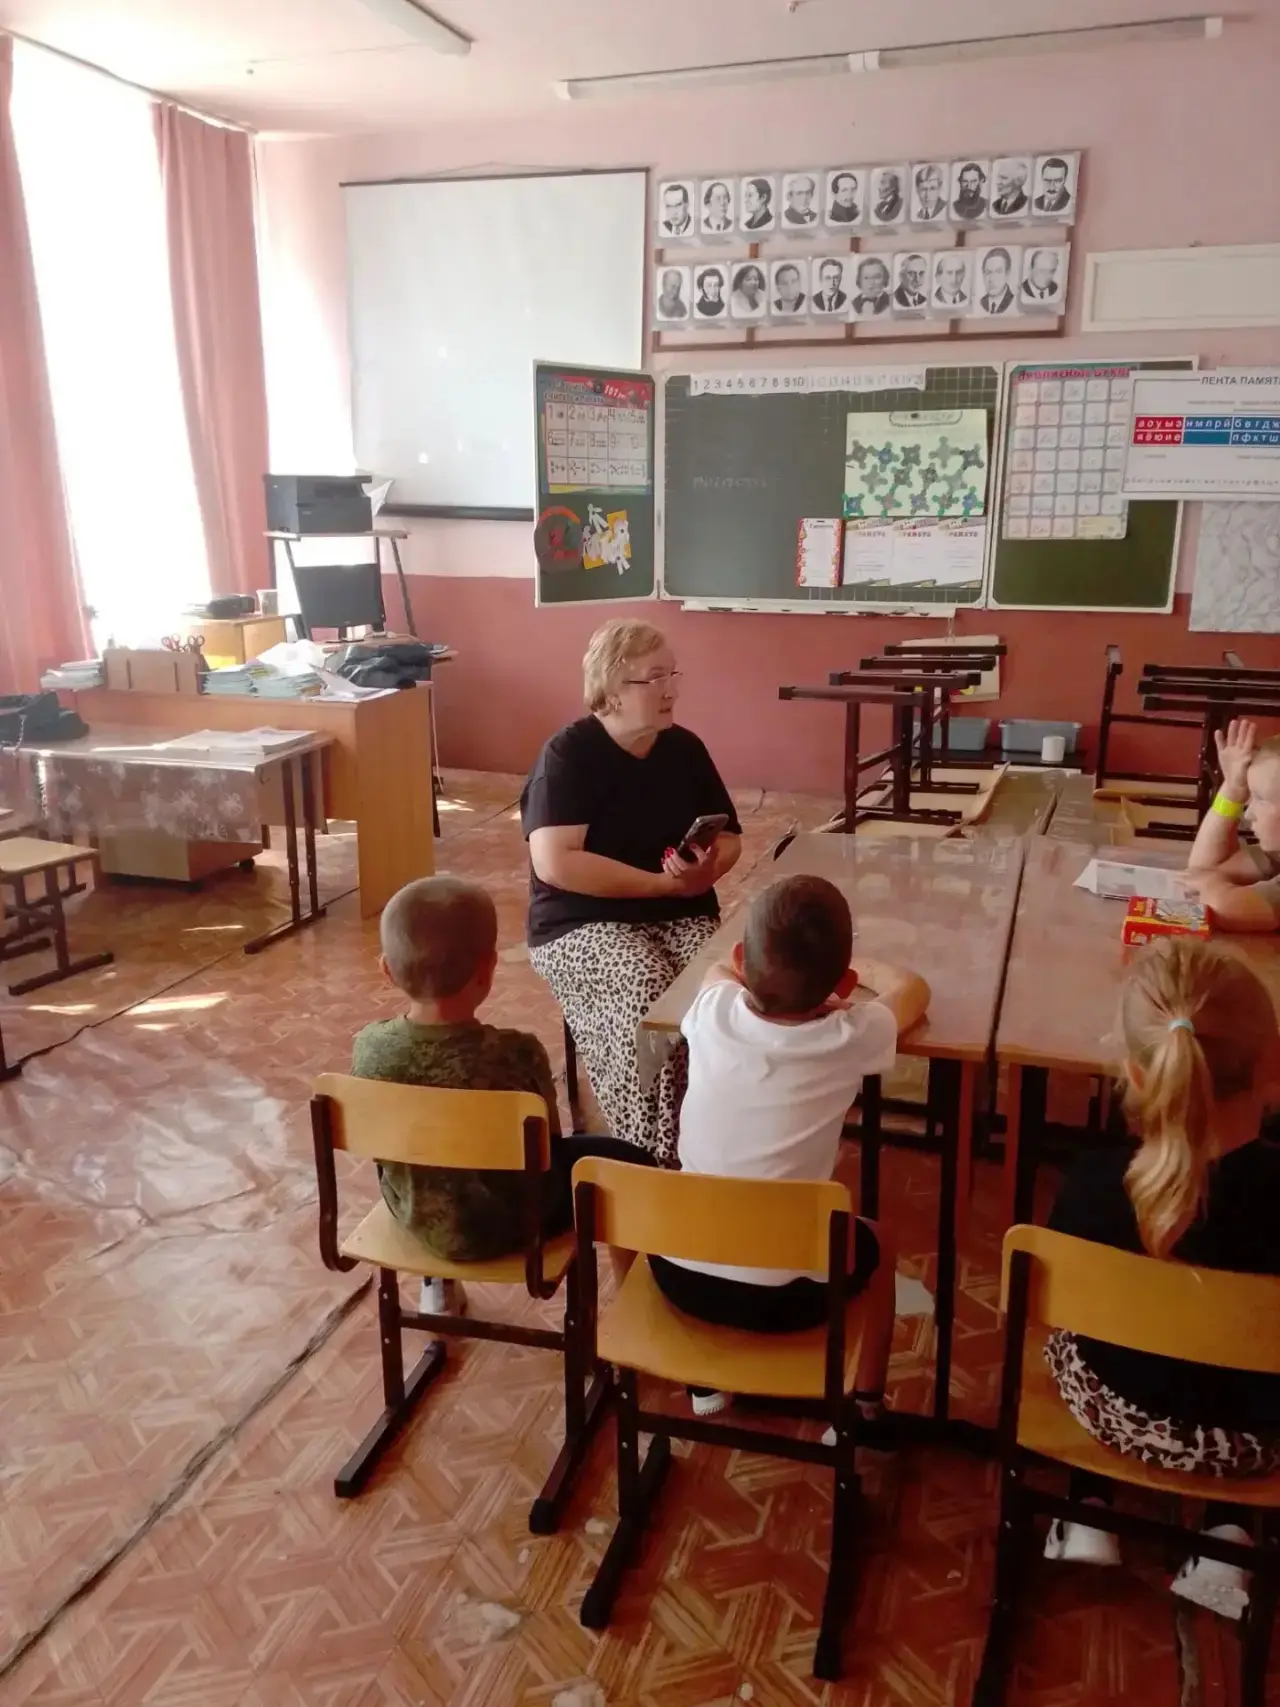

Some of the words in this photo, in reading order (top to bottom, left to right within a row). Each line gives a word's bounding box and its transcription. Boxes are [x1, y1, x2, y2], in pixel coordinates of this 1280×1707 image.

[703, 378, 710, 389] 2
[714, 378, 721, 389] 3
[726, 378, 732, 388] 4
[737, 377, 744, 388] 5
[749, 377, 756, 388] 6
[761, 377, 768, 387] 7
[772, 376, 779, 387] 8
[784, 376, 790, 387] 9
[793, 376, 804, 387] 10
[1201, 376, 1237, 385] ЛЕНТА
[1240, 375, 1280, 385] ПАМЯТ
